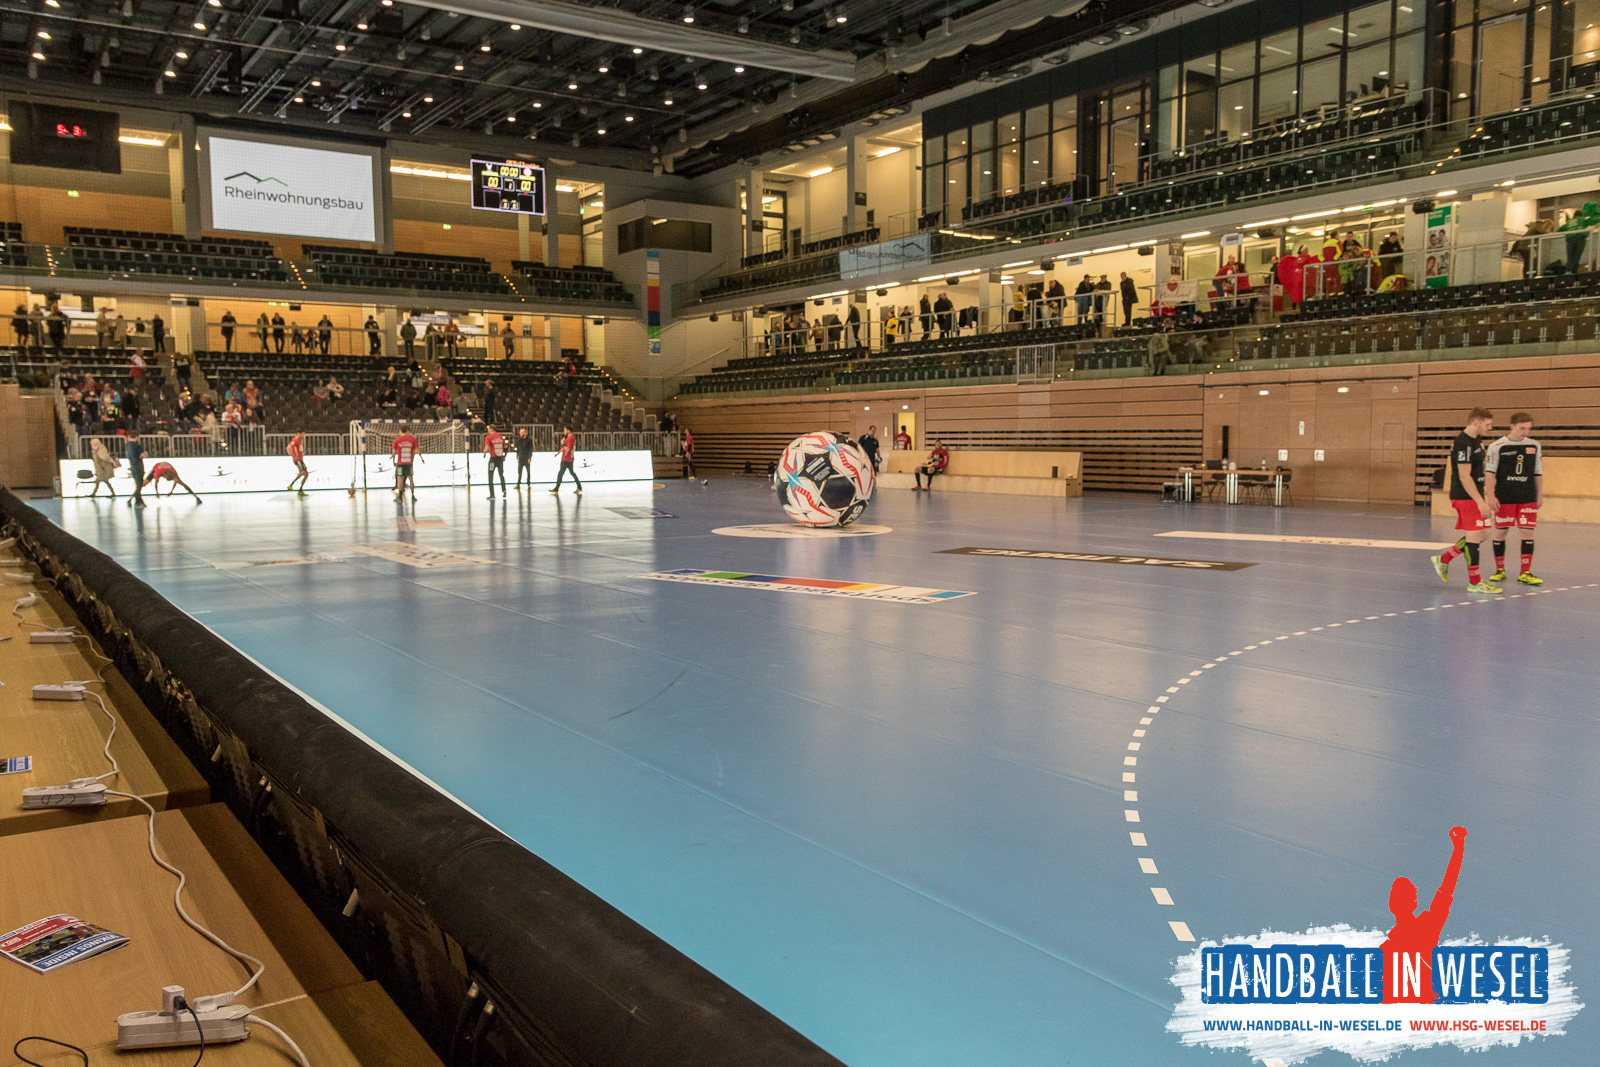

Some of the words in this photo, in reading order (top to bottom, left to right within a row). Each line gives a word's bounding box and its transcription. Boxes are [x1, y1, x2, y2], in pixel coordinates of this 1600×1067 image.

[224, 185, 364, 210] Rheinwohnungsbau
[968, 548, 1225, 568] SALMING
[637, 574, 772, 589] düsseldo
[77, 933, 119, 951] VIKINGS
[42, 949, 79, 967] INSIDE
